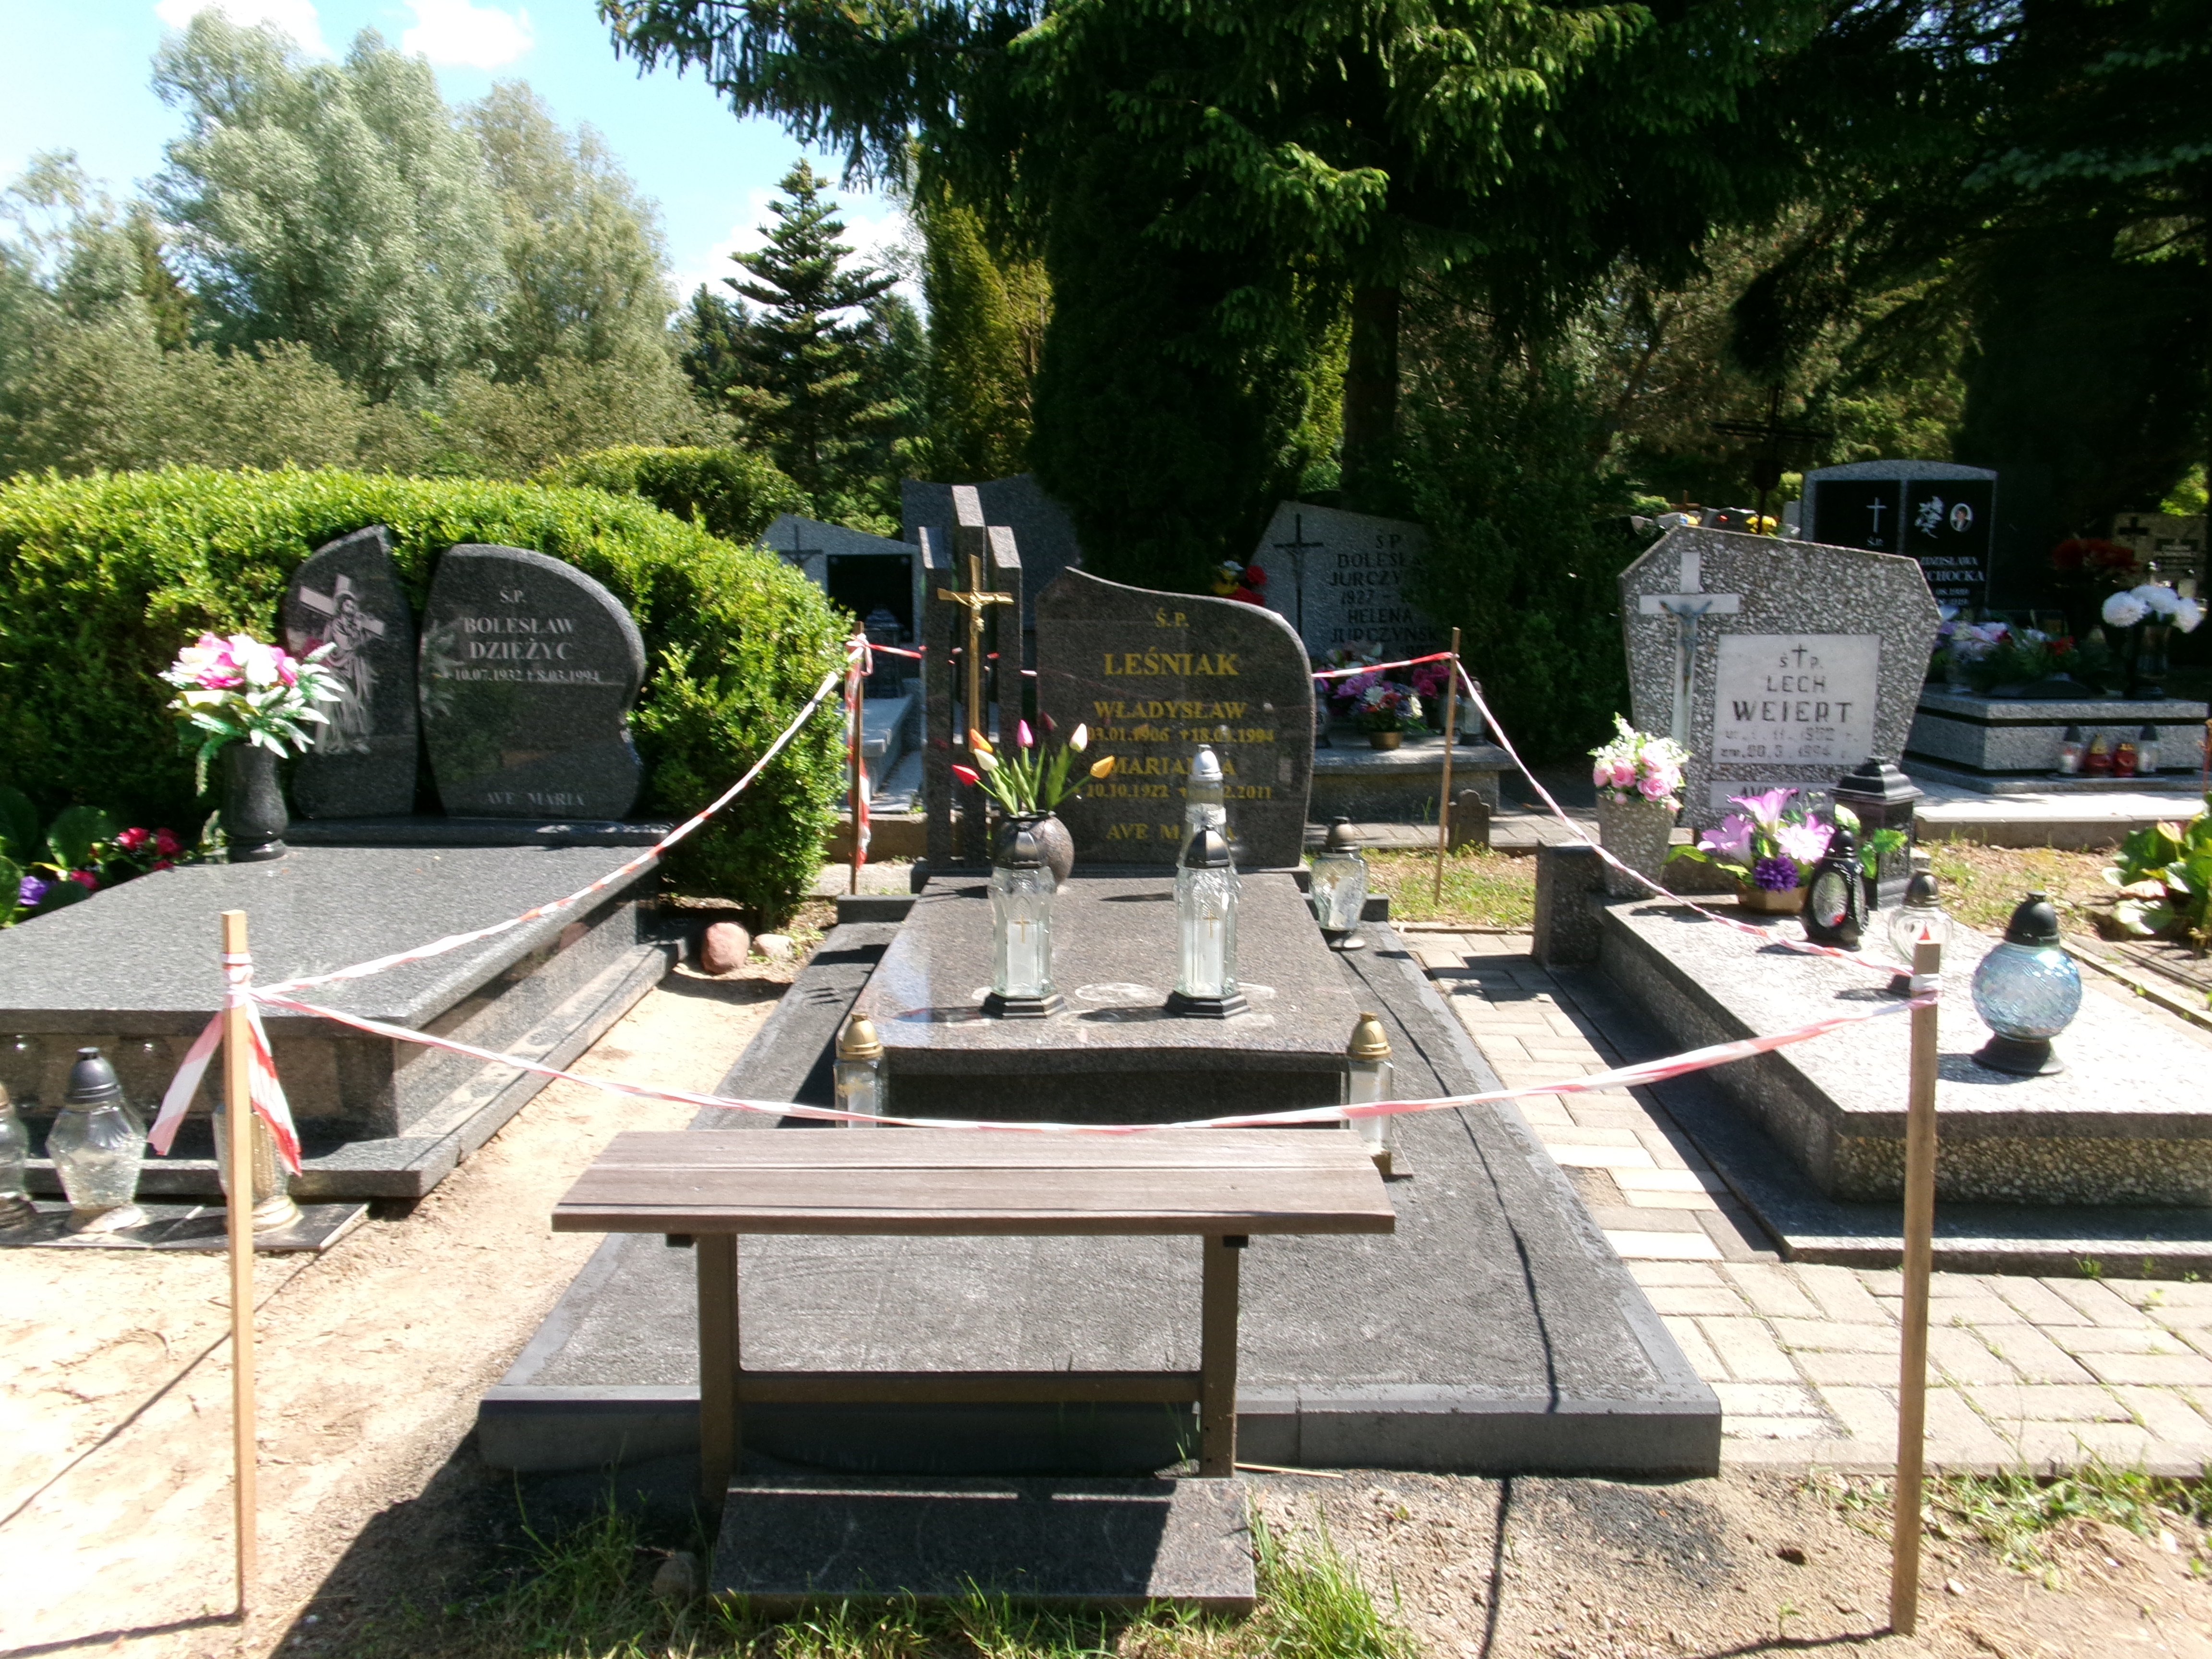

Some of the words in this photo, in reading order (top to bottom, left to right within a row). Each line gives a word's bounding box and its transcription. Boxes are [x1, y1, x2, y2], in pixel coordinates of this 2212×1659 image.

[1337, 552, 1422, 568] BOLESŁA
[1329, 570, 1403, 587] JURCZY
[1926, 570, 1985, 582] CHOCKA
[1347, 607, 1414, 624] HELENA
[463, 617, 576, 634] BOLESŁAW
[469, 637, 573, 660] DZIEŻYC
[1104, 646, 1239, 676] LEŚNIAK
[1767, 674, 1826, 693] LECH
[1093, 700, 1248, 719] WŁADYSŁAW
[1732, 700, 1853, 723] WEIERT
[1112, 757, 1237, 775] MARIAA
[1106, 822, 1149, 840] AVE
